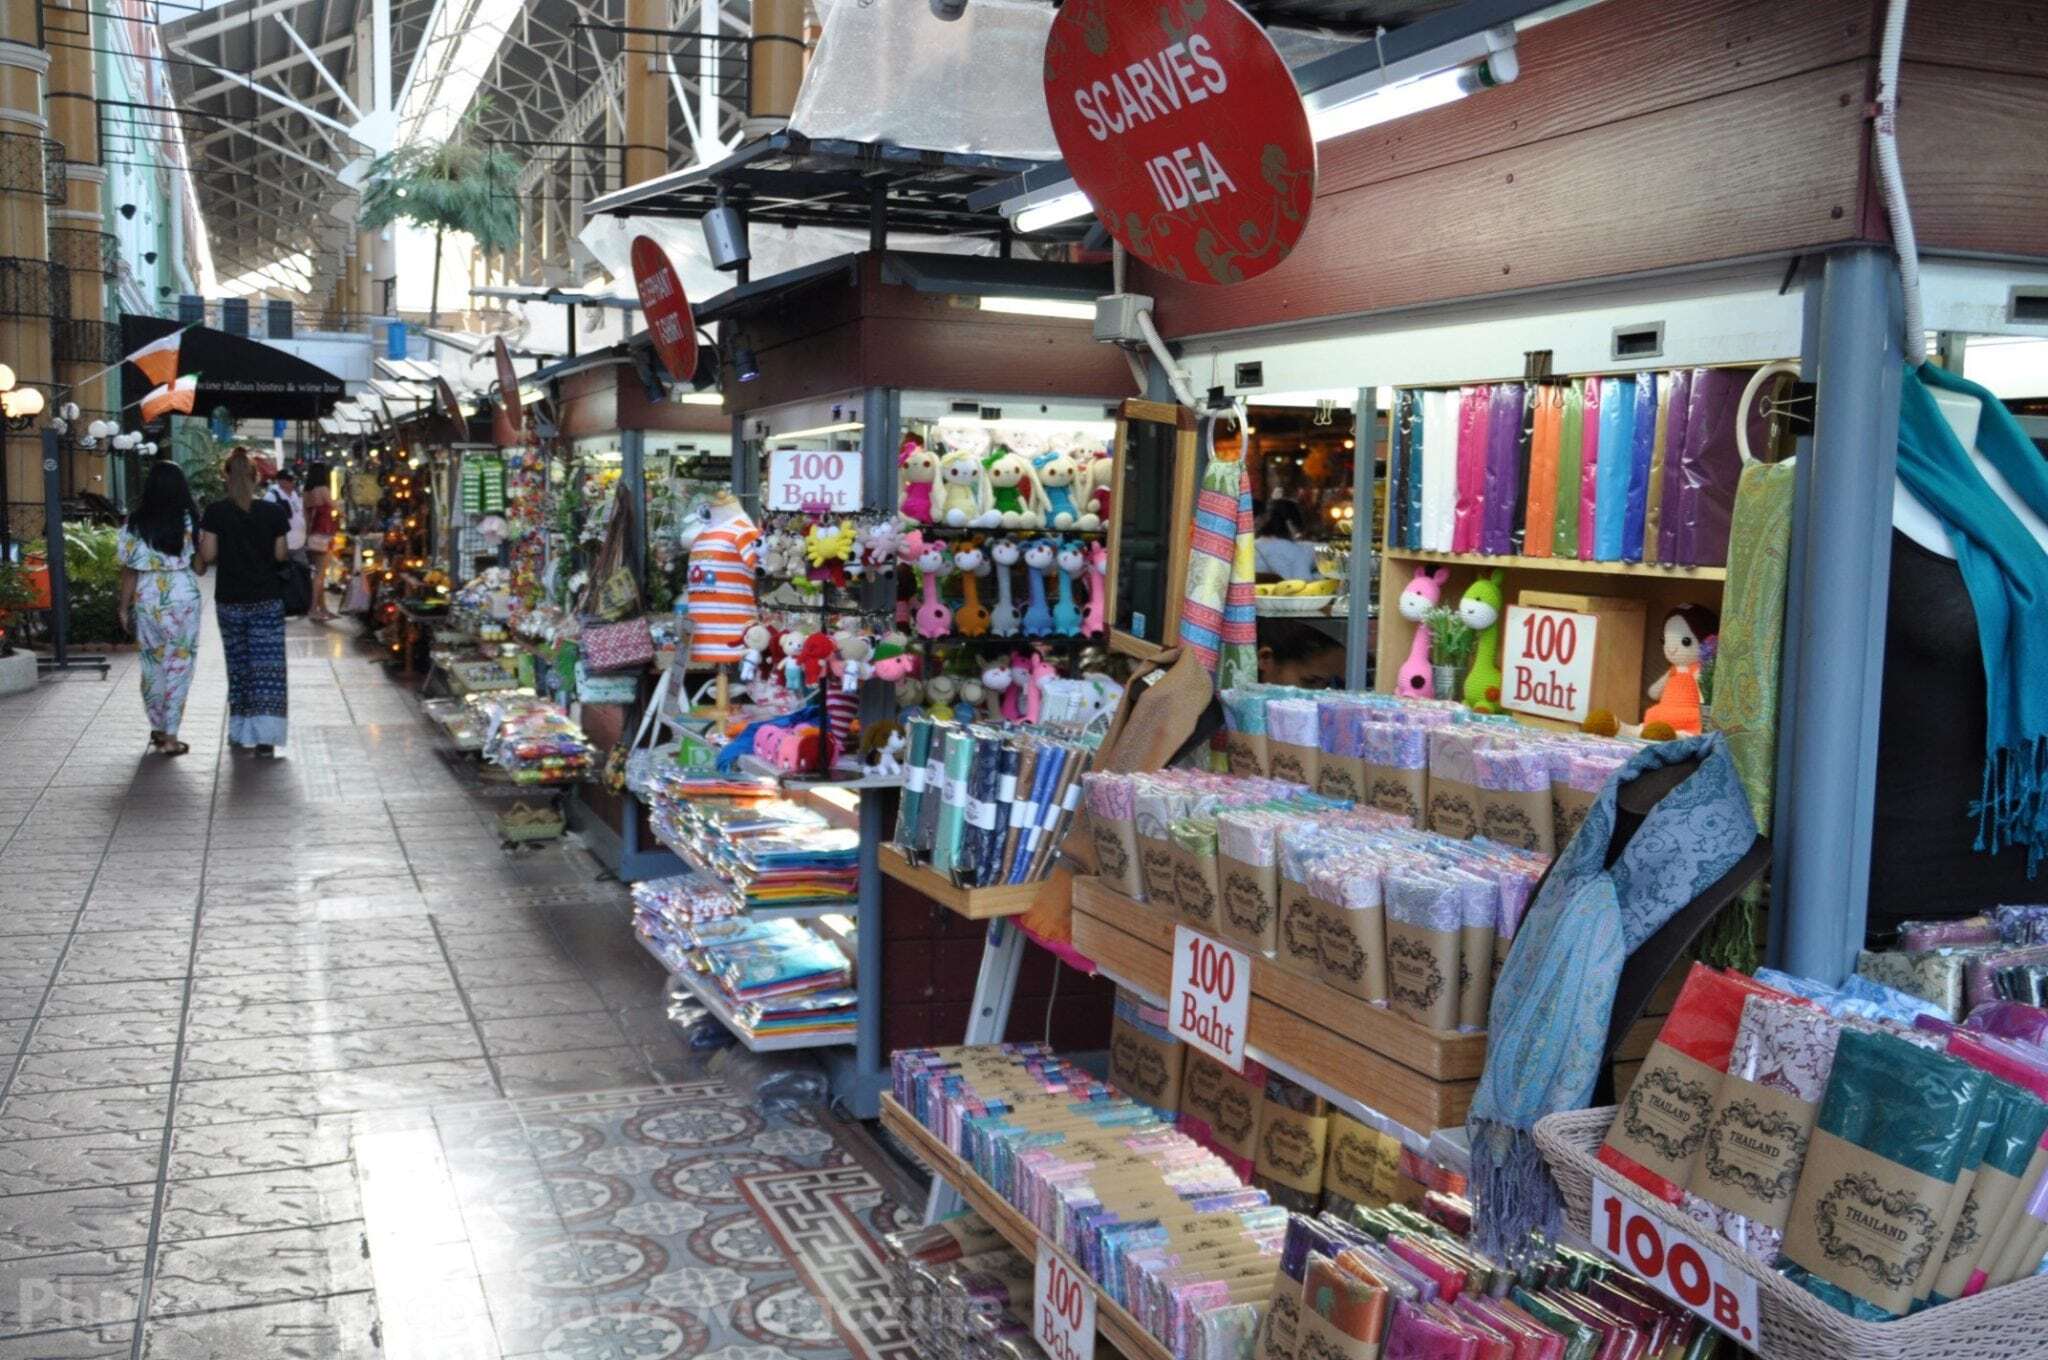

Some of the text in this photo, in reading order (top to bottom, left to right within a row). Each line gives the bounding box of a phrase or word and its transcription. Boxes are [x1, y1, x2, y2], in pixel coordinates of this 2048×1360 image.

[1074, 34, 1228, 142] SCARVES
[1145, 141, 1238, 212] IDEA
[788, 454, 845, 480] 100
[782, 484, 848, 507] Baht
[1521, 612, 1577, 665] 100
[1513, 665, 1578, 711] Baht
[1188, 937, 1236, 1003] 100
[1179, 991, 1235, 1055] Baht
[1648, 1094, 1692, 1123] THAILAND
[1729, 1131, 1782, 1159] THAILAND
[1845, 1205, 1909, 1243] THAILAND
[1046, 1257, 1084, 1332] 100
[1042, 1303, 1081, 1360] Bah
